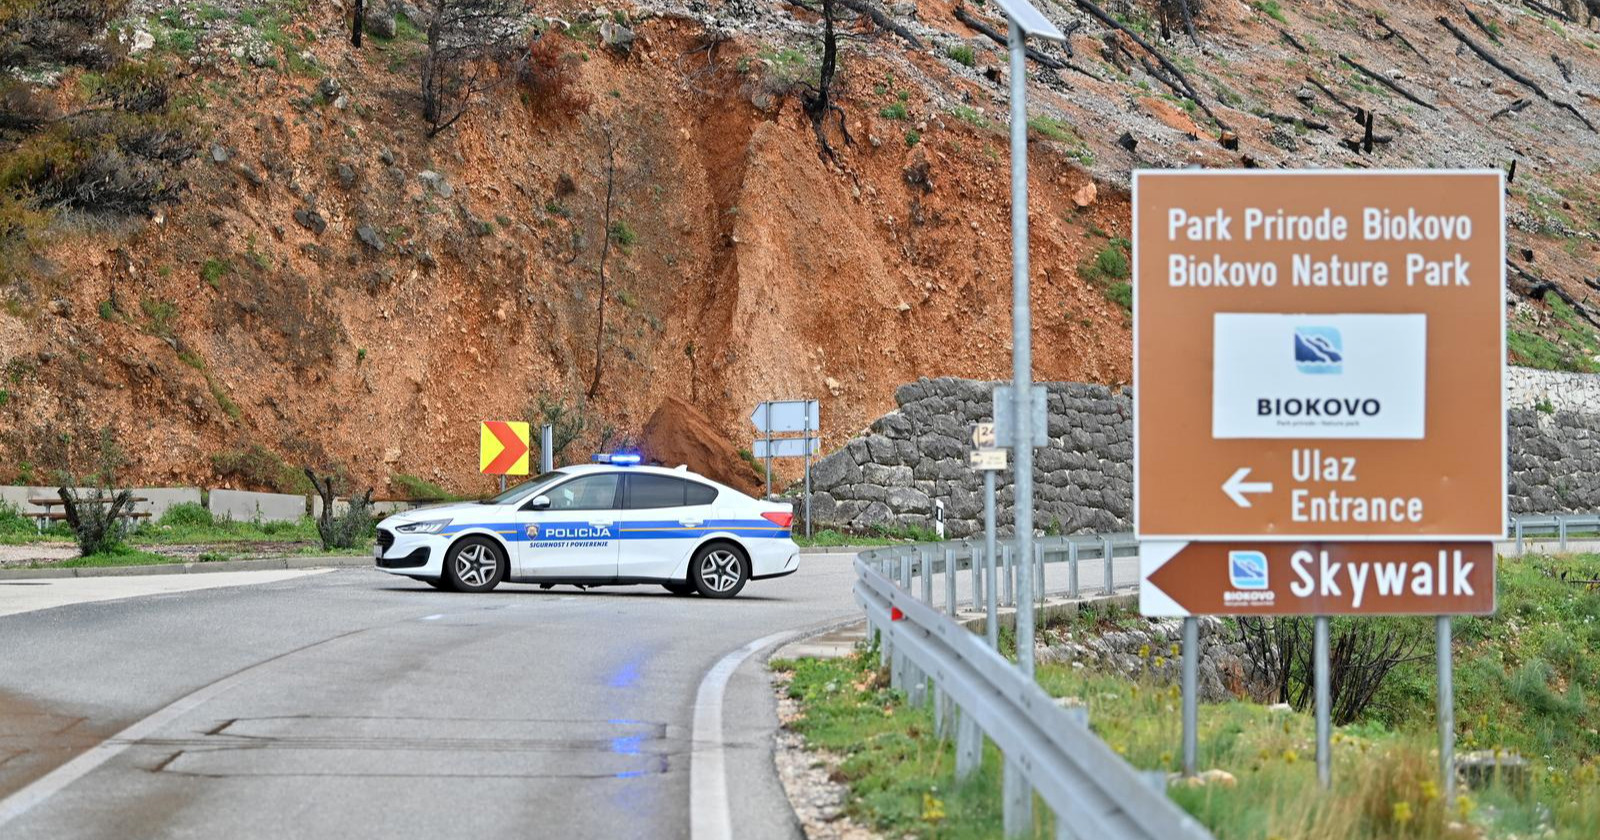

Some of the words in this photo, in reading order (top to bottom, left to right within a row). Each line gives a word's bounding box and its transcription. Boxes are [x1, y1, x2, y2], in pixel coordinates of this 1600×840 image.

[1167, 207, 1233, 241] Park
[1244, 207, 1349, 241] Prirode
[1363, 206, 1473, 241] Biokovo
[1167, 253, 1279, 287] Biokovo
[1292, 253, 1390, 287] Nature
[1406, 253, 1472, 287] Park
[1257, 398, 1381, 416] BIOKOVO
[1291, 448, 1357, 483] Ulaz
[1291, 488, 1424, 523] Entrance
[545, 527, 611, 538] POLICIJA
[1290, 549, 1475, 609] Skywalk
